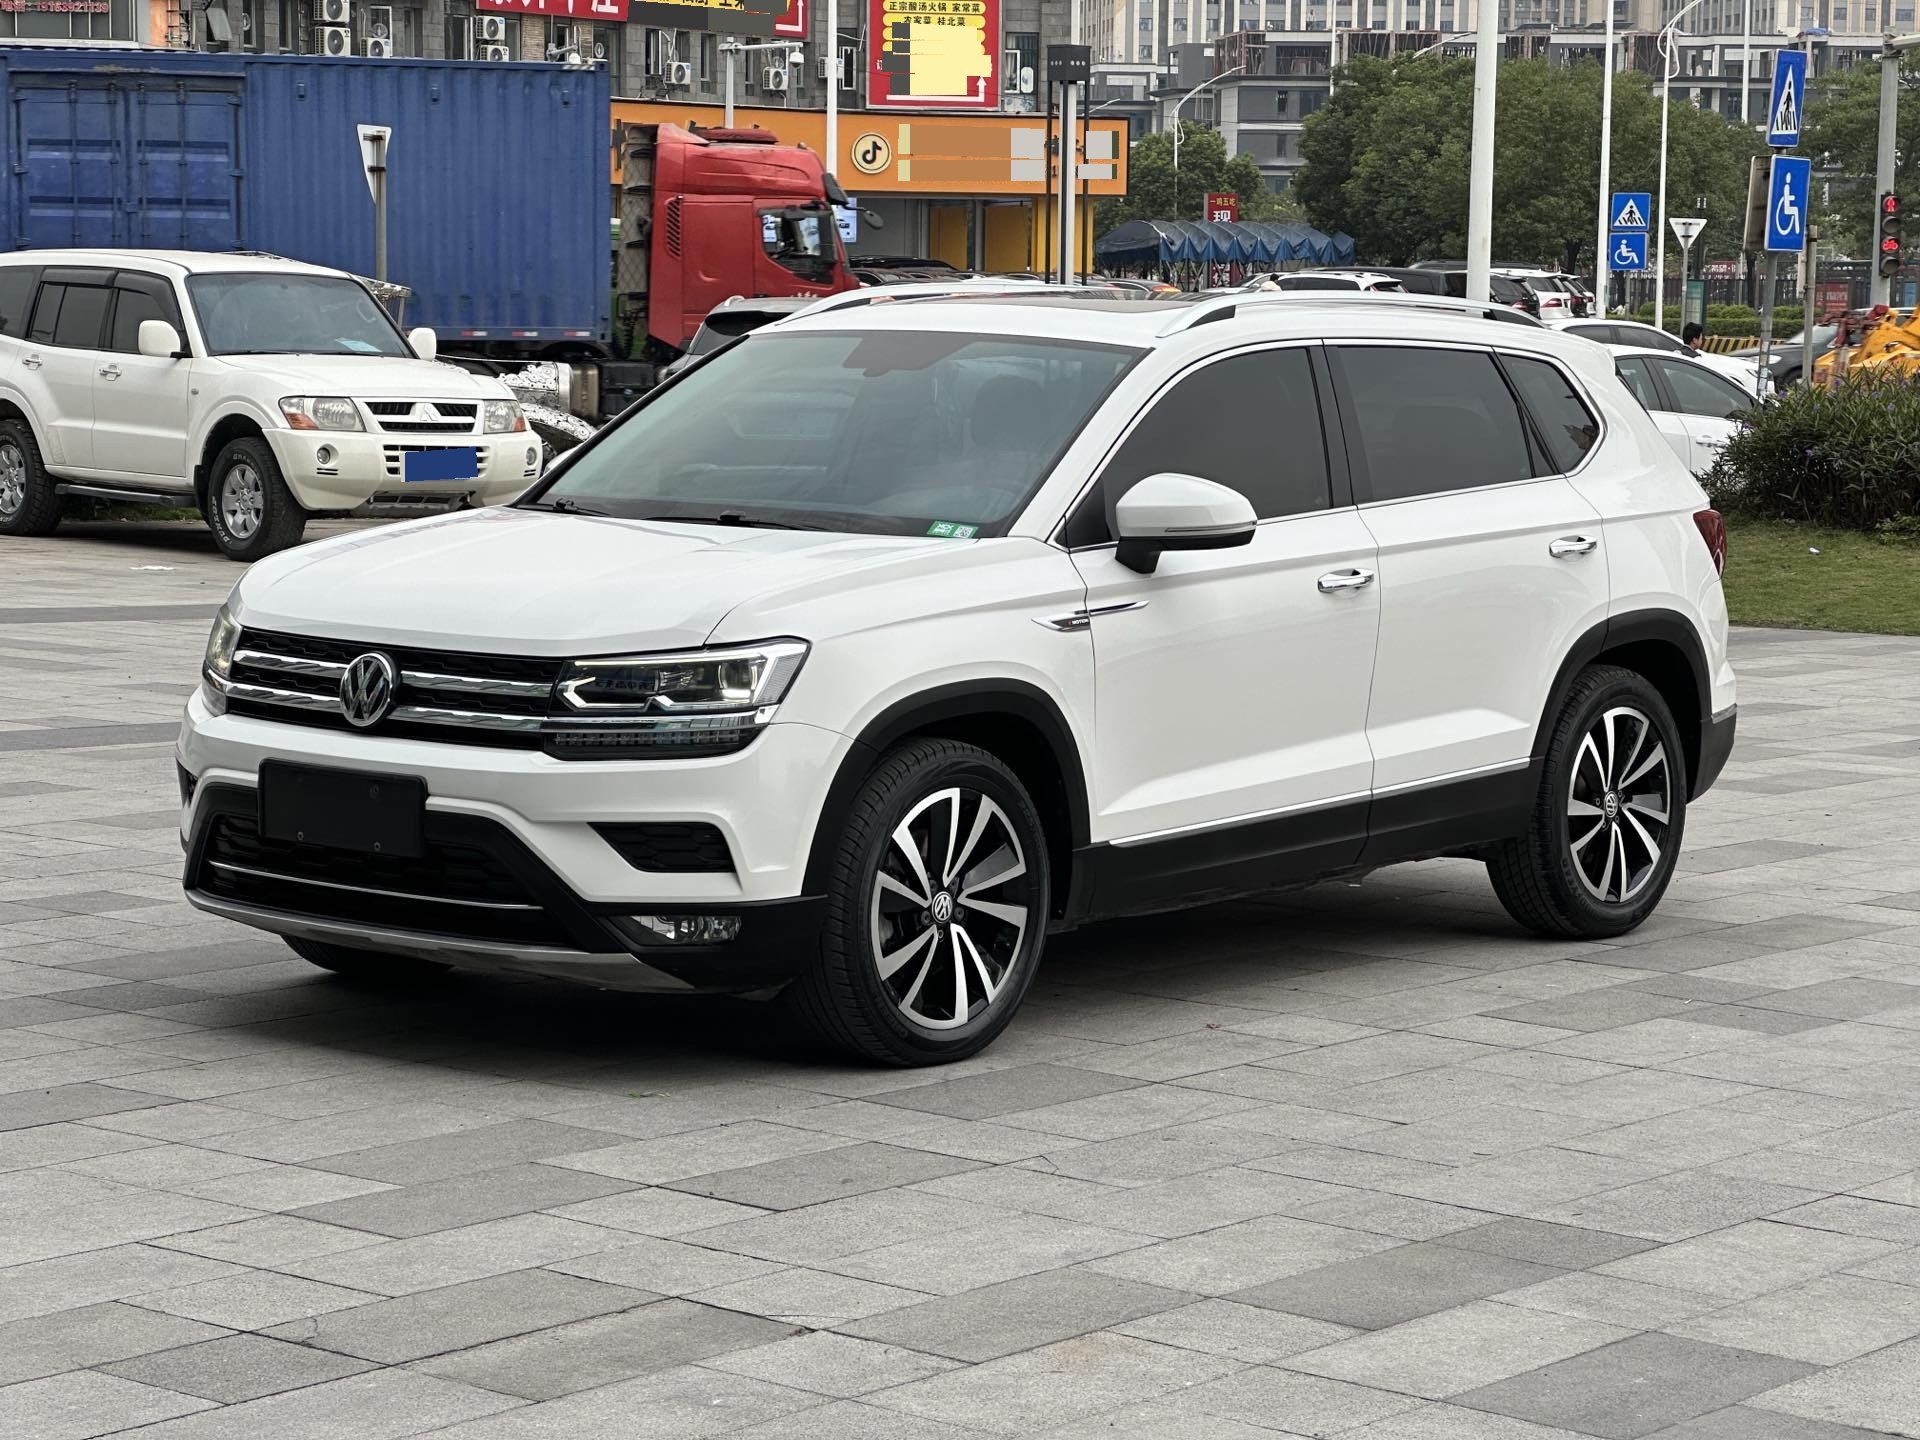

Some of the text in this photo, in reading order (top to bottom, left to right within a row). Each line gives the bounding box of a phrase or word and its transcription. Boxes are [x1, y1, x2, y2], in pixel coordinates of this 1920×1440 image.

[889, 1, 980, 13] 正宗酸汤火锅 家常菜
